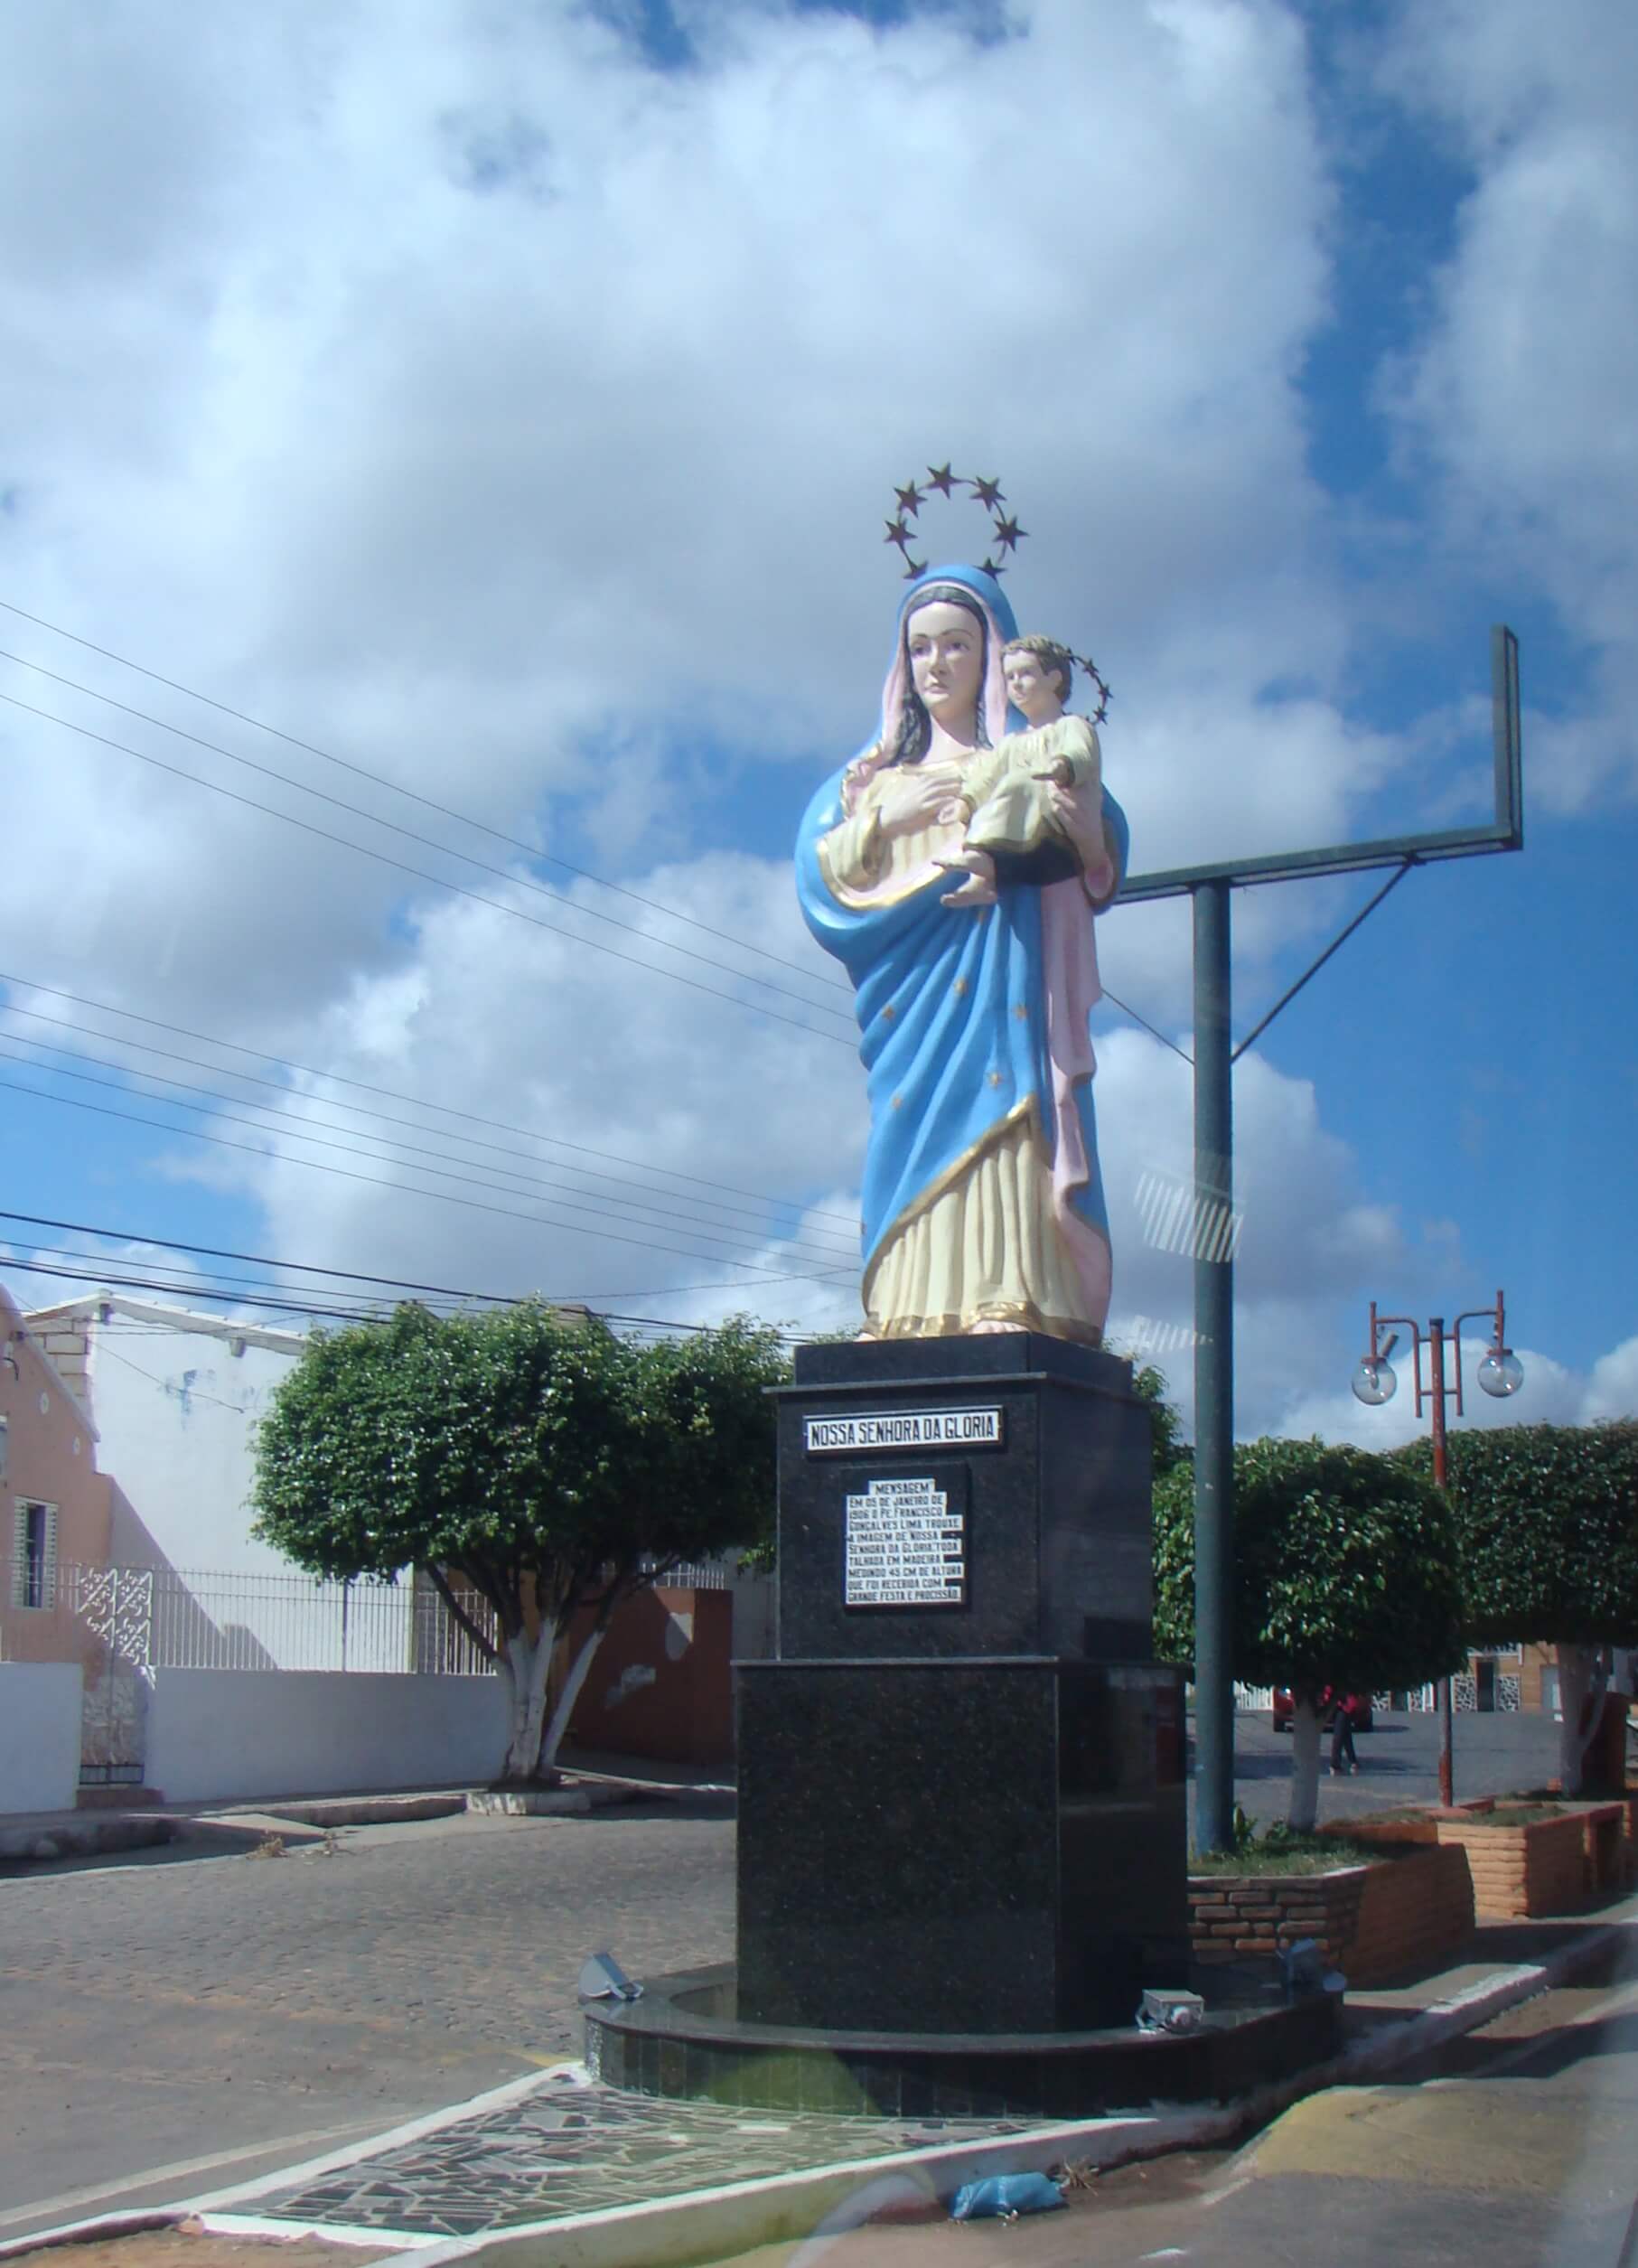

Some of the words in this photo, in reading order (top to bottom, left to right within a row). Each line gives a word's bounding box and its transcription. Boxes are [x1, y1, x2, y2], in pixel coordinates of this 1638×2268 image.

[811, 1422, 856, 1446] NOSSA
[857, 1419, 919, 1443] SENHORA
[923, 1418, 941, 1439] DA
[944, 1414, 994, 1439] GLORIA
[875, 1483, 929, 1495] MENSAGEM
